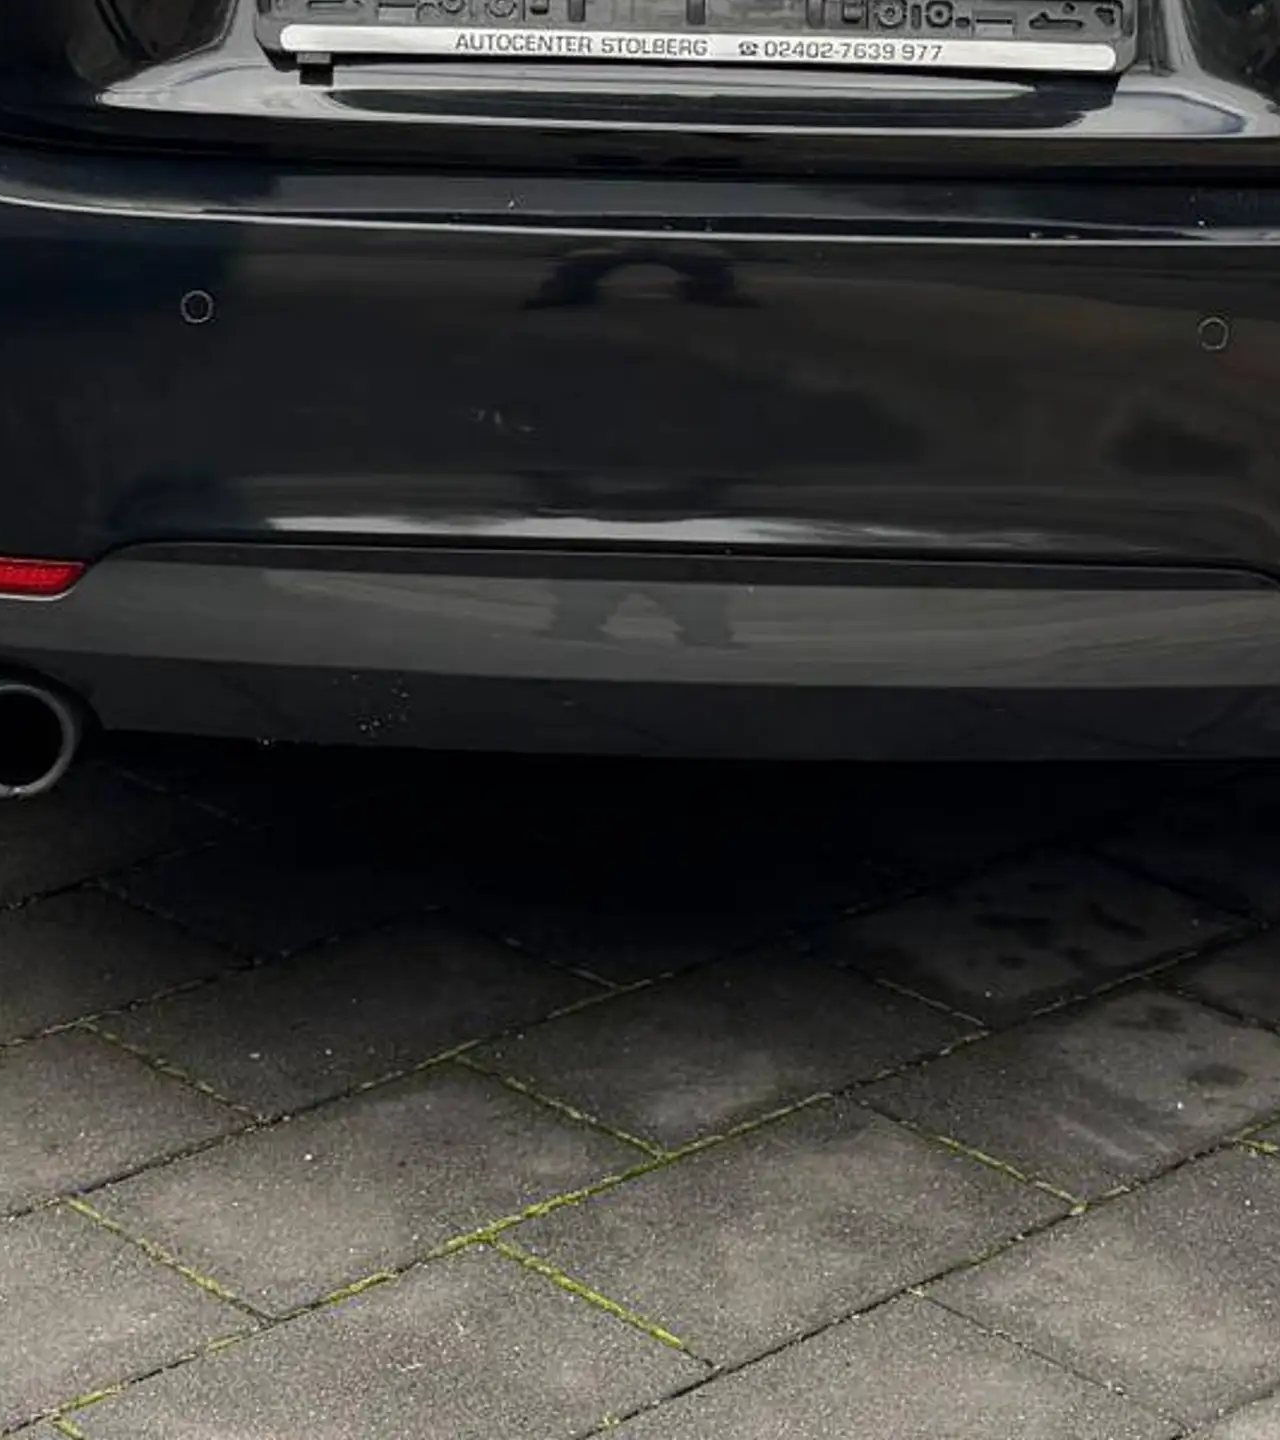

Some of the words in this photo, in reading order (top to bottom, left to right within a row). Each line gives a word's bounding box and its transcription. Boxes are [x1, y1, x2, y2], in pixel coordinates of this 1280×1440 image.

[454, 33, 593, 54] AUTOCENTER
[601, 37, 709, 57] STOLBERG
[763, 39, 895, 60] 02402-7639
[902, 42, 944, 61] 977
